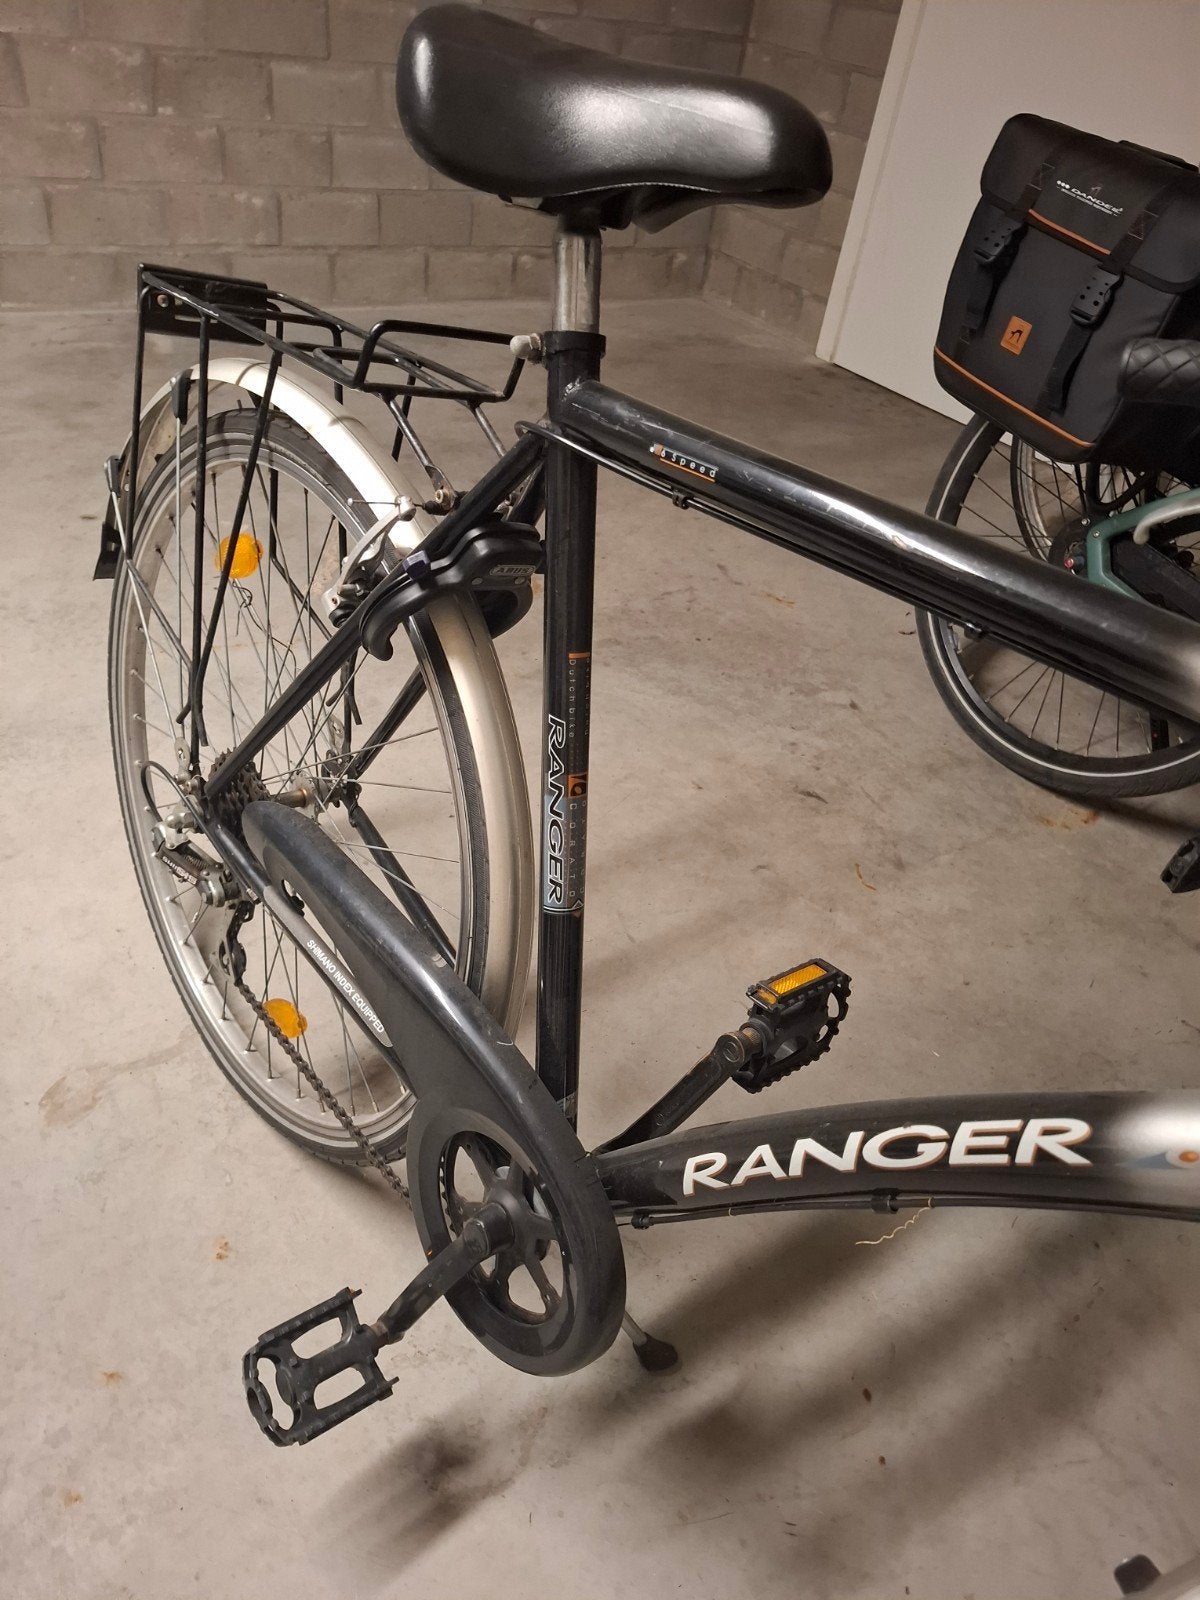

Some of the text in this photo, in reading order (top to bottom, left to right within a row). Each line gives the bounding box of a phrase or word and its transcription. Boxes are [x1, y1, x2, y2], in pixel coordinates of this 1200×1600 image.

[547, 713, 566, 905] RANGER
[306, 939, 385, 1033] SHIMANO INDEX EQUIPPED
[682, 1117, 1094, 1197] RANGER
